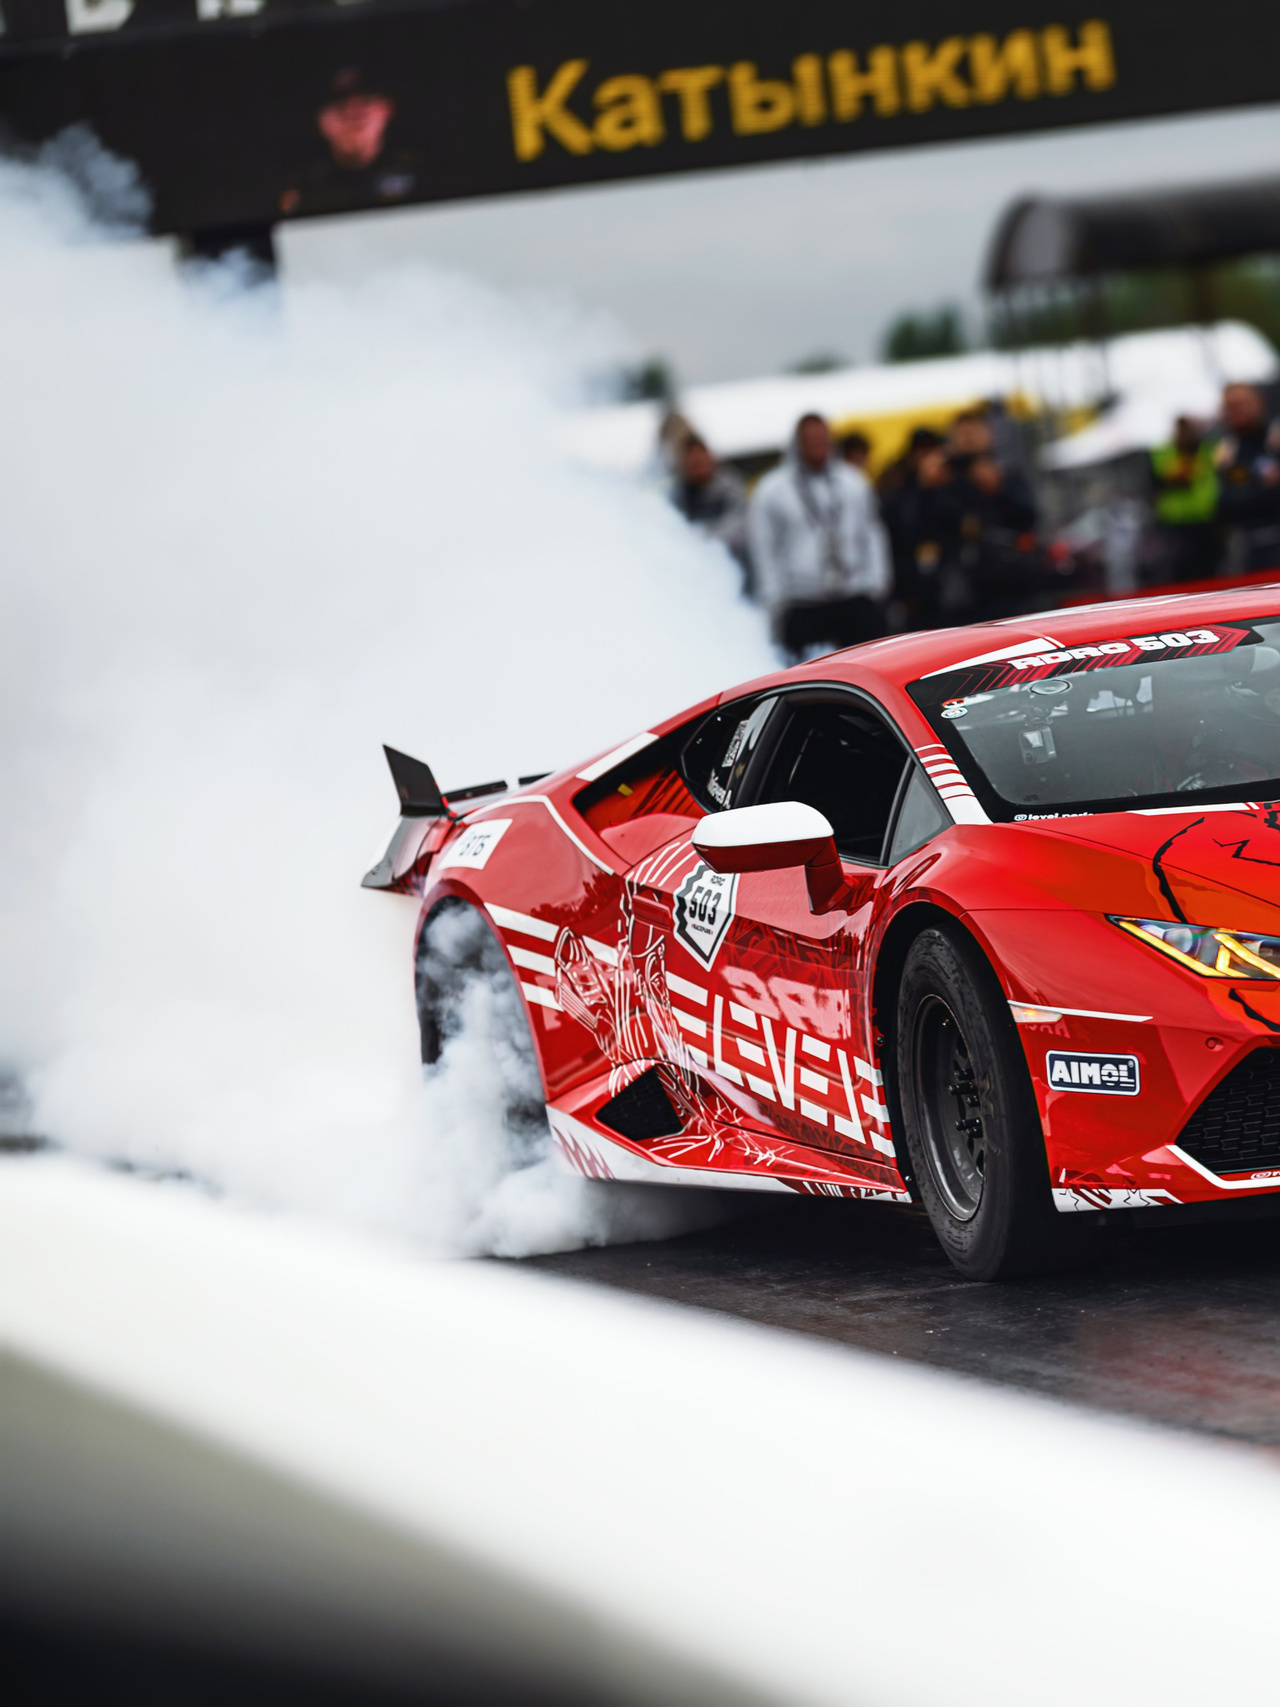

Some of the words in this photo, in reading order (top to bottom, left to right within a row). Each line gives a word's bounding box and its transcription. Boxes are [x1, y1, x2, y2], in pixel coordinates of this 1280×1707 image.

[507, 18, 1116, 162] Катынкин
[1130, 629, 1220, 651] 503
[688, 885, 722, 926] 503
[1051, 1060, 1135, 1087] AIMOL
